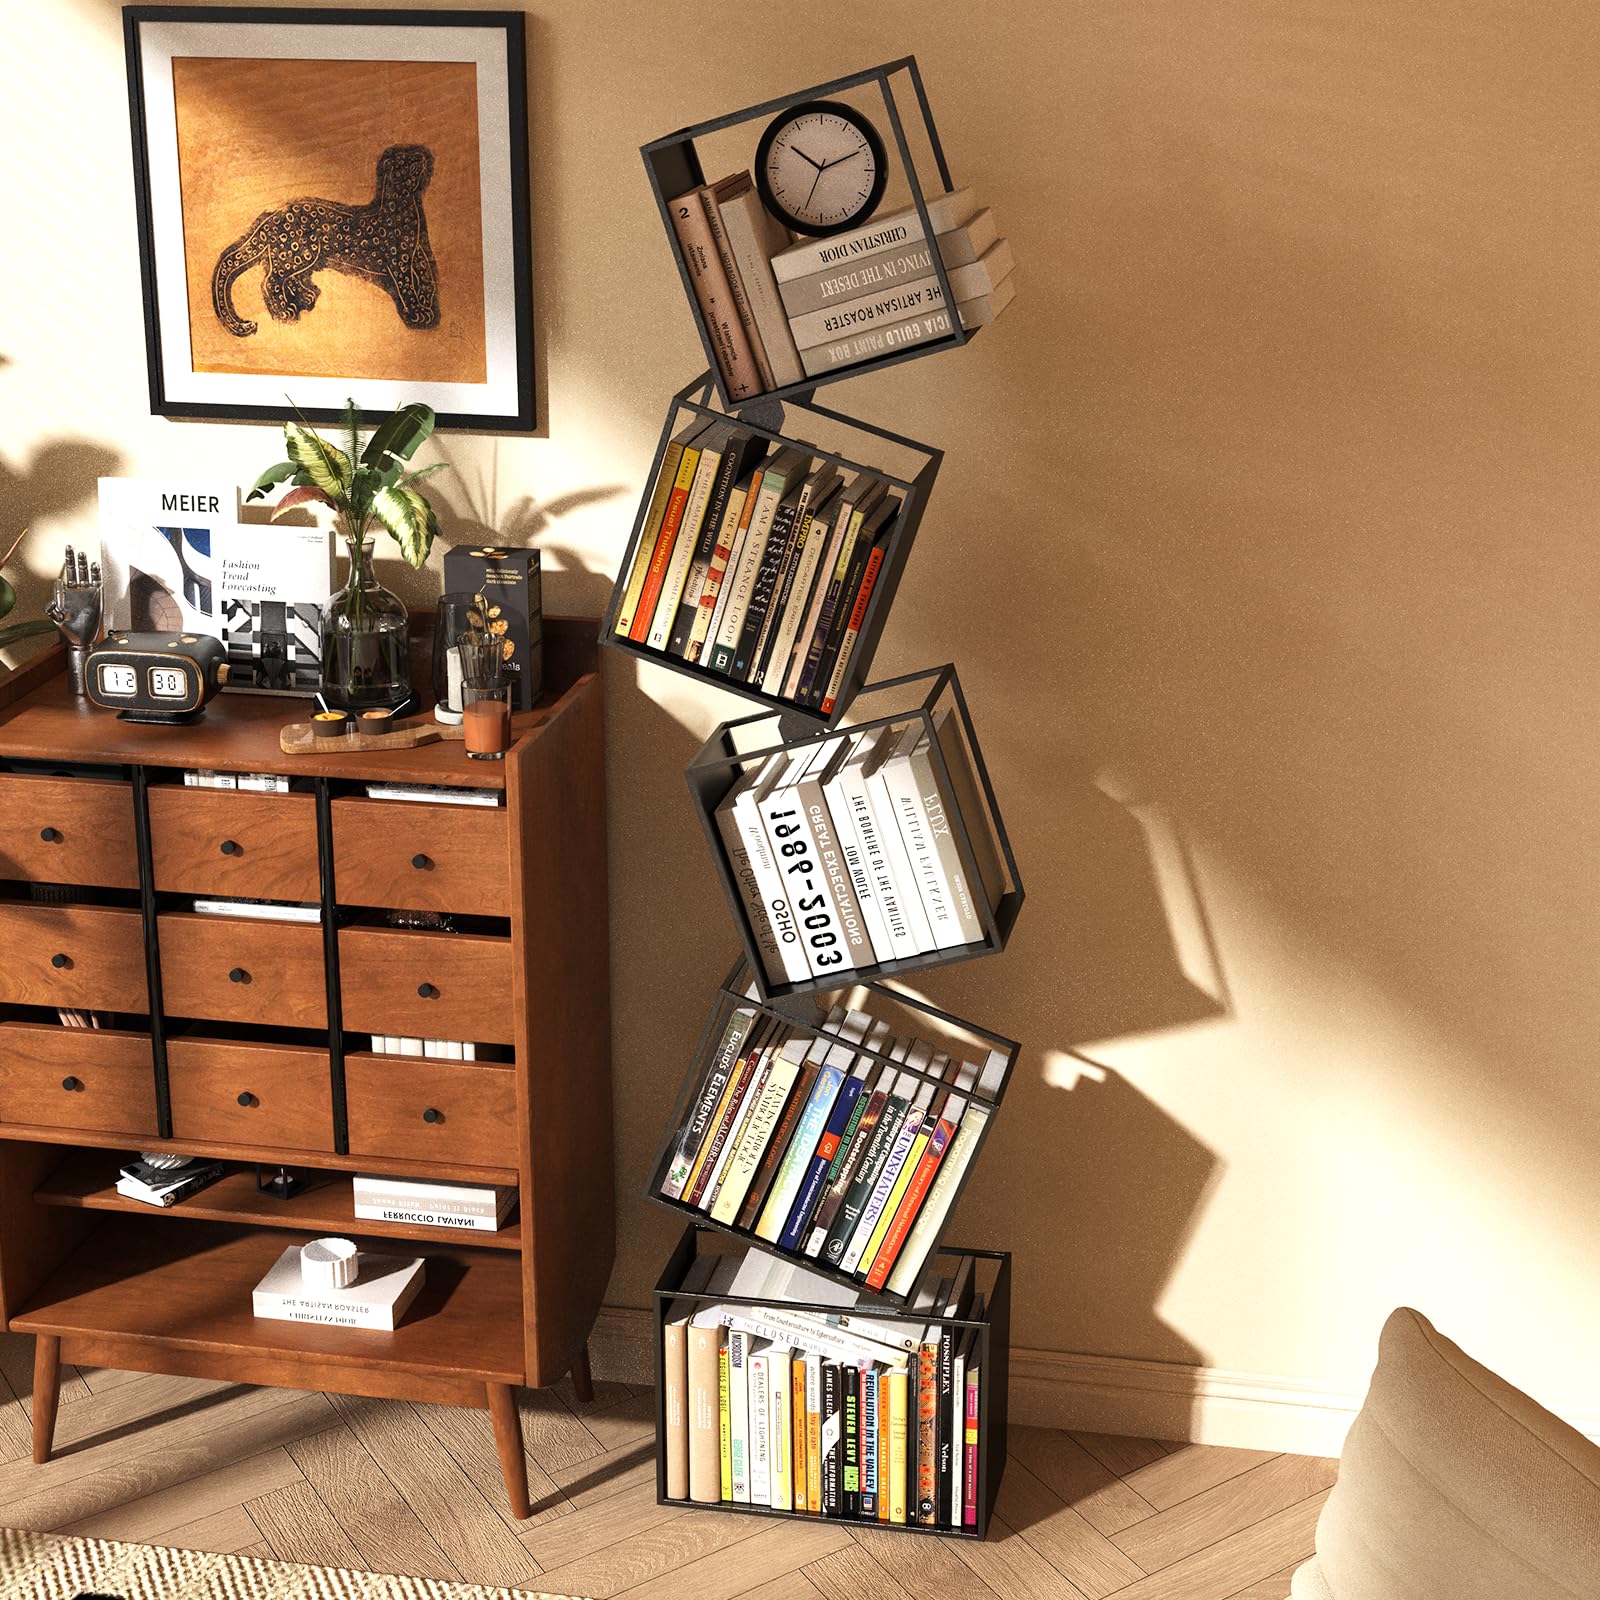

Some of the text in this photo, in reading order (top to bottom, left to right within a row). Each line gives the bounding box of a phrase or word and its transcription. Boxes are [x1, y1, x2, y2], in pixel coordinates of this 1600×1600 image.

[677, 205, 691, 220] 2
[695, 245, 710, 269] Zmiana
[817, 224, 908, 264] CHRISTIAN DIOR
[818, 249, 931, 298] IVING IN THE DESERT
[822, 285, 942, 331] HE ARTISAN ROASTER
[827, 308, 966, 363] TICIA GUILD PAINT BOX
[697, 470, 711, 501] WHERE
[700, 451, 736, 553] COGNITION IN THE WILD
[161, 493, 219, 512] MEIER
[666, 493, 682, 527] Visual
[758, 505, 770, 525] AM
[677, 503, 703, 568] MATHEMATICS
[717, 510, 737, 559] THE HAND
[755, 528, 764, 538] A
[779, 491, 809, 575] THE INNER GAME OF TENNIS
[795, 513, 813, 549] IMPRO
[222, 559, 259, 569] Fashion
[651, 529, 672, 573] Thinking
[789, 551, 800, 571] KEITH
[221, 570, 249, 580] Trend
[221, 581, 276, 595] Forecasting
[668, 569, 683, 601] COMES
[686, 565, 703, 599] Hutchins
[735, 541, 760, 602] STRANGE
[661, 603, 673, 628] FROM
[722, 605, 741, 643] LOOP
[784, 604, 799, 637] ERROR
[113, 671, 176, 690] 12 30
[717, 1030, 743, 1071] EUCLID'S
[764, 1085, 787, 1120] LEWIS
[811, 1069, 832, 1103] Gertner
[821, 1079, 834, 1097] Jon
[689, 1072, 727, 1135] ELEMENTS
[749, 1081, 778, 1132] SYMBOLIC
[804, 1104, 825, 1132] THE
[705, 1084, 744, 1163] The Rules of ALGEBRA
[731, 1117, 750, 1149] ELEMENTARY
[763, 1089, 803, 1168] MATHEMATICAL LOGIC
[825, 1095, 869, 1181] REVOLUTION IN MINIATURE
[734, 1133, 755, 1167] LOGIC
[791, 1131, 814, 1164] IDEA
[853, 1104, 896, 1184] in the Twentieth Century
[865, 1110, 906, 1186] A History of Computing
[926, 1156, 934, 1164] A
[936, 1126, 973, 1187] Programming
[716, 1148, 737, 1184] MATHEMATICS
[814, 1158, 826, 1175] History
[830, 1129, 868, 1195] Bootstrapping
[915, 1162, 932, 1186] History
[799, 1179, 819, 1211] Semiconductor
[861, 1135, 913, 1223] UNIX-HATERS
[912, 1185, 922, 1195] of
[901, 1192, 919, 1219] Personal
[912, 1186, 944, 1236] Languages
[788, 1209, 806, 1237] Engineering
[883, 1216, 907, 1255] Workstations
[754, 1324, 828, 1354] CLOSED WORLD
[762, 1312, 776, 1321] From
[775, 1316, 811, 1333] Counterculture
[815, 1329, 845, 1344] Cyberculture
[757, 1372, 765, 1404] DEALERS
[808, 1366, 816, 1385] where
[825, 1369, 833, 1391] JAMES
[731, 1334, 743, 1477] MICROCOSM GEORGE GILDER
[757, 1408, 765, 1416] OF
[809, 1387, 817, 1410] wizards
[846, 1395, 856, 1434] STEVEN
[940, 1334, 950, 1472] POSSIPLEX Nelson
[808, 1426, 817, 1434] up
[809, 1412, 817, 1425] stay
[865, 1374, 875, 1489] REVOLUTION IN THE VALLEY
[810, 1436, 818, 1449] late
[846, 1438, 856, 1462] LEVY
[828, 1461, 836, 1506] INFORMATION
